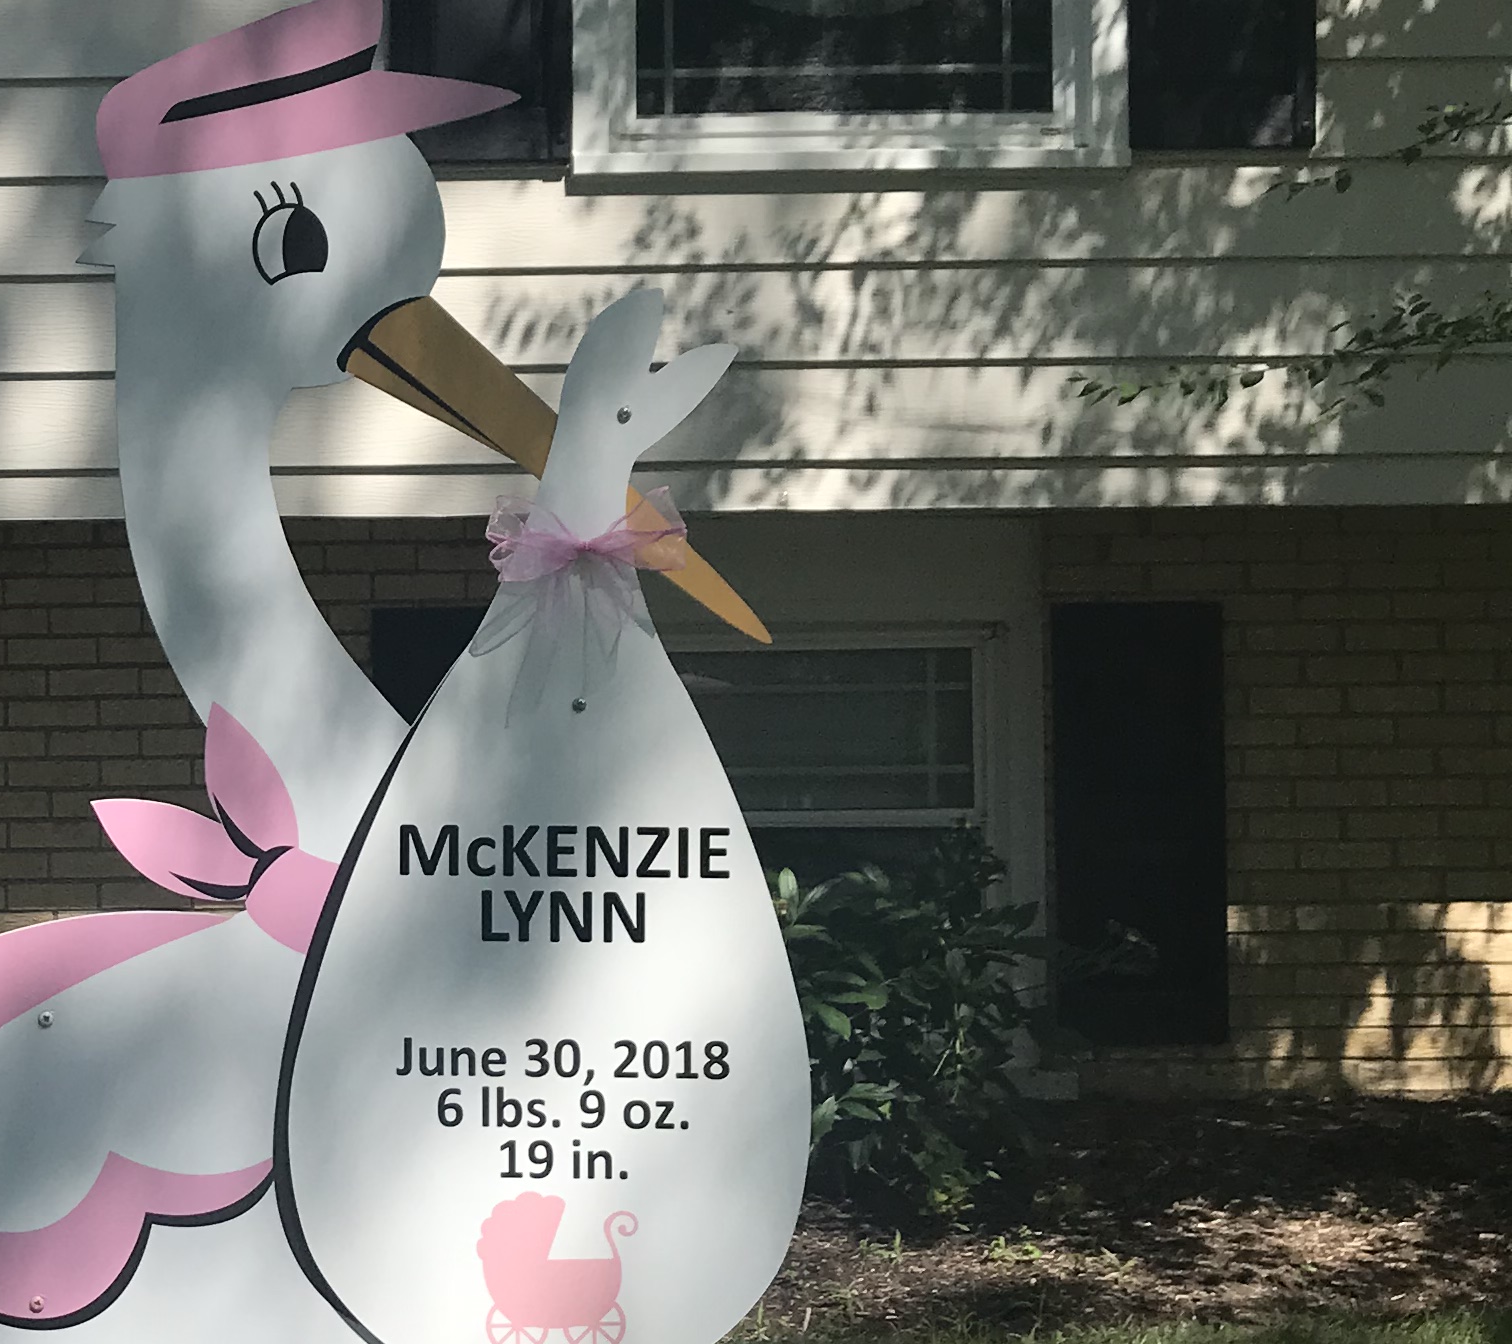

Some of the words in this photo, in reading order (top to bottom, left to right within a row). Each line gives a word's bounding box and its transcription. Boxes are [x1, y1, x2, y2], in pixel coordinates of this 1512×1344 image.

[398, 824, 731, 879] McKENZIE
[480, 889, 646, 944] LYNN
[395, 1037, 508, 1078] June
[524, 1038, 595, 1087] 30,
[613, 1040, 731, 1081] 2018
[436, 1088, 464, 1128] 6
[481, 1086, 562, 1129] lbs.
[579, 1089, 606, 1130] 9
[622, 1100, 690, 1131] oz.
[499, 1139, 554, 1180] 19
[571, 1139, 629, 1181] in.
